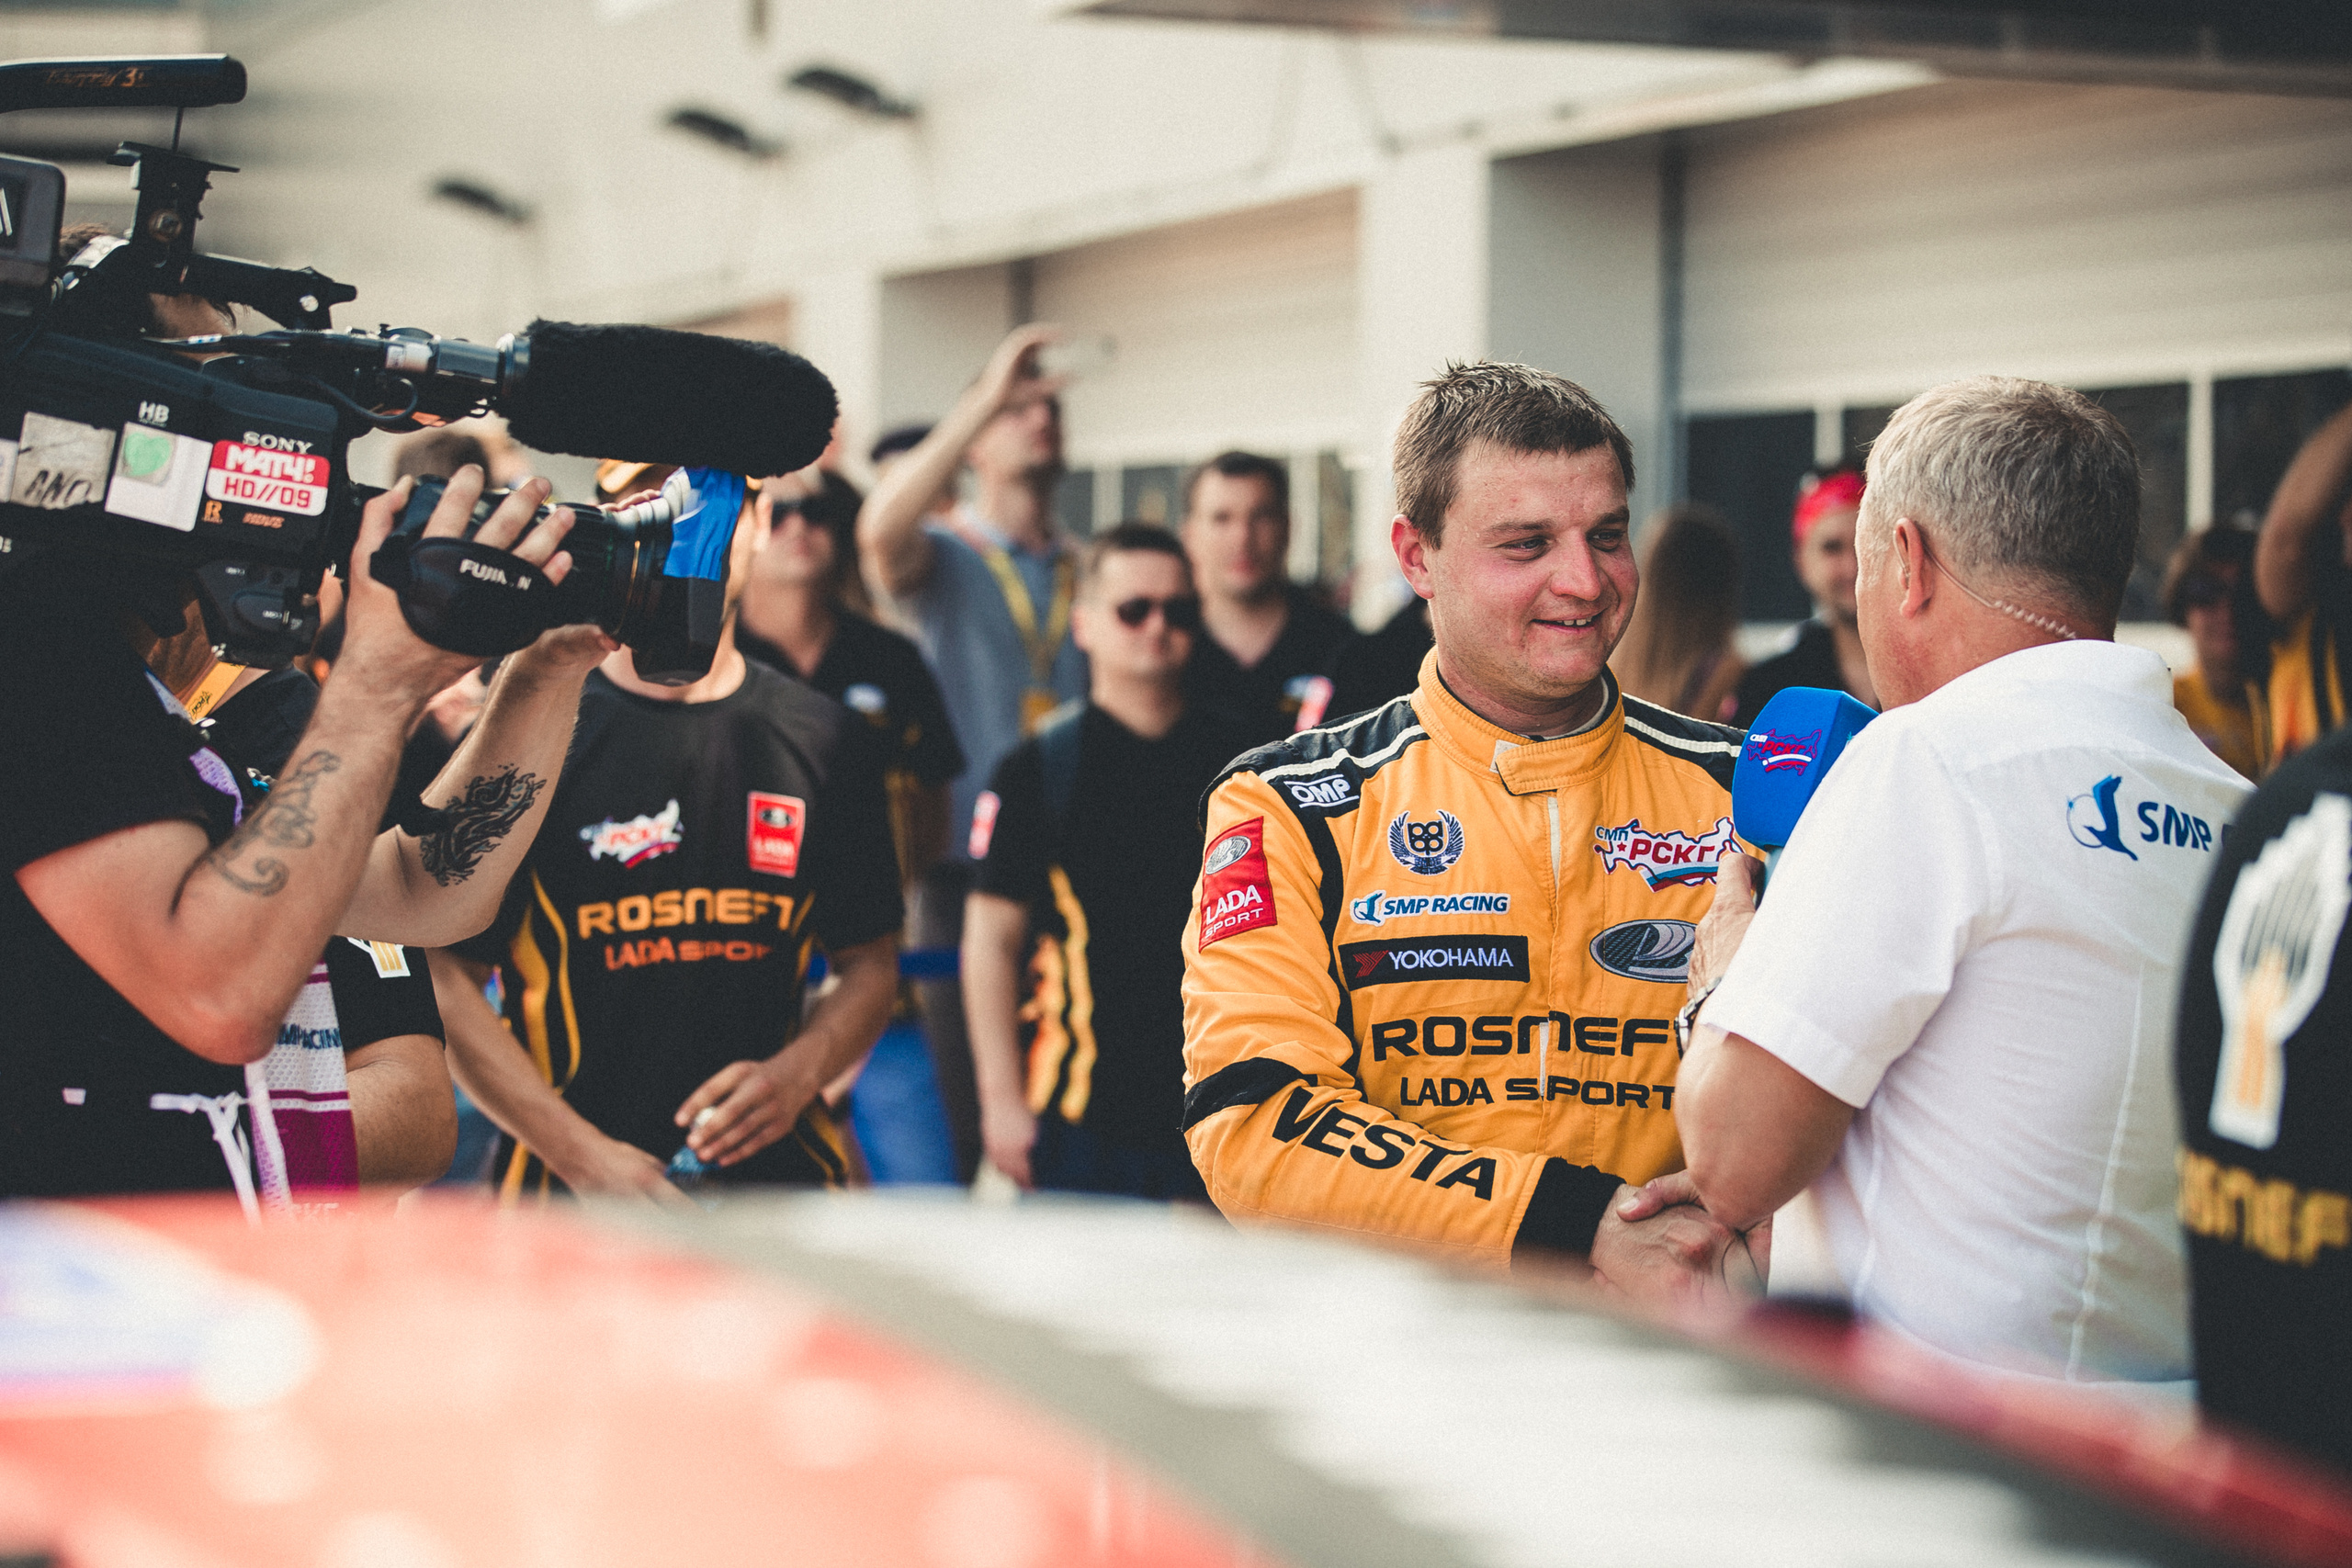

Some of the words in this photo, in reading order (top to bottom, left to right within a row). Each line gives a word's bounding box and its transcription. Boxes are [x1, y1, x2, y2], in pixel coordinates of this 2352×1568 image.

[139, 400, 170, 423] HB
[243, 431, 313, 455] SONY
[224, 477, 311, 508] HD//09
[460, 558, 532, 591] FUJINN
[1291, 778, 1351, 804] OMP
[1596, 826, 1629, 841] СМП
[2137, 801, 2212, 852] SMP
[1629, 838, 1715, 864] РСКГ
[1205, 885, 1263, 925] LADA
[1384, 897, 1429, 915] SMP
[1431, 895, 1509, 912] RACING
[1204, 908, 1264, 939] SPORT
[605, 937, 675, 971] LADA
[1388, 948, 1514, 970] YOKOHAMA
[1372, 1011, 1669, 1062] ROSNEF
[1400, 1077, 1495, 1107] LADA
[1506, 1076, 1675, 1110] SPORT
[1272, 1086, 1498, 1201] VESTA
